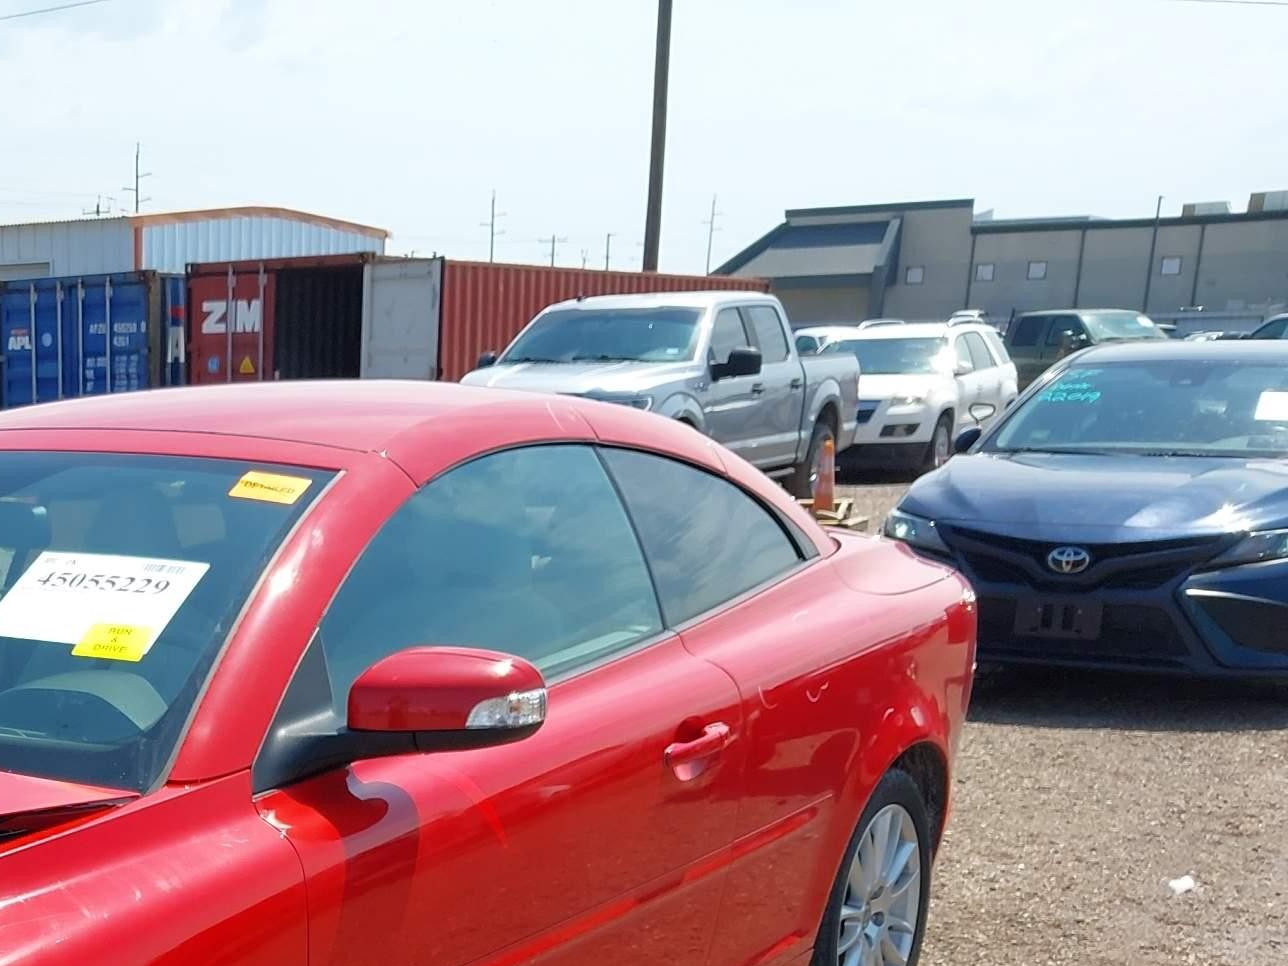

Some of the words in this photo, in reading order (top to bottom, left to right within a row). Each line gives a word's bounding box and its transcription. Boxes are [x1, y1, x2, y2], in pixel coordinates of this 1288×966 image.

[201, 299, 261, 334] ZIM
[8, 335, 32, 351] APL
[37, 571, 171, 595] 45055229
[107, 626, 132, 637] RUN
[92, 643, 128, 653] DRIVE
